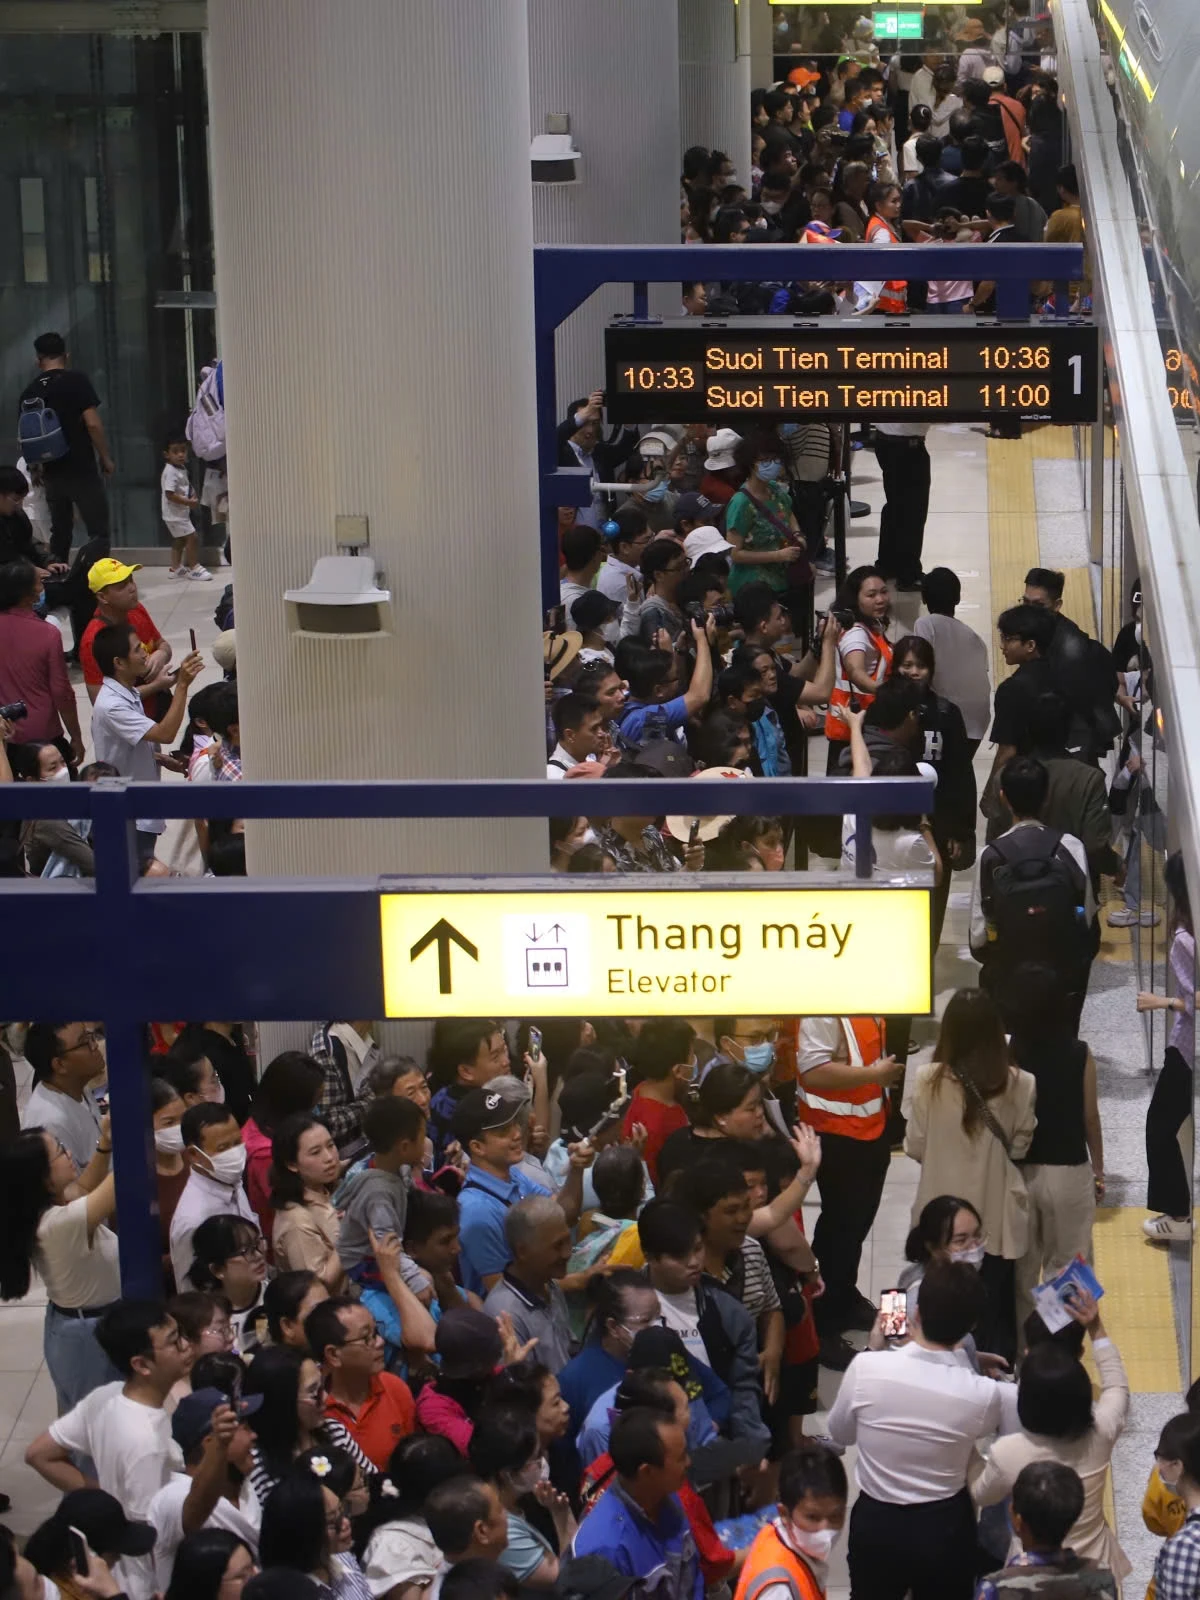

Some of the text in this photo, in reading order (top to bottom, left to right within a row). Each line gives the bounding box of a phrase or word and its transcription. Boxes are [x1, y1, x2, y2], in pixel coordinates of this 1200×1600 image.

[705, 346, 1050, 370] Suoi Tien Terminal 10:36
[624, 366, 695, 389] 10:33
[1068, 355, 1082, 395] 1
[706, 384, 1050, 408] Suoi Tien Terminal 11:00
[607, 912, 853, 960] Thang máy
[608, 969, 731, 994] Elevator
